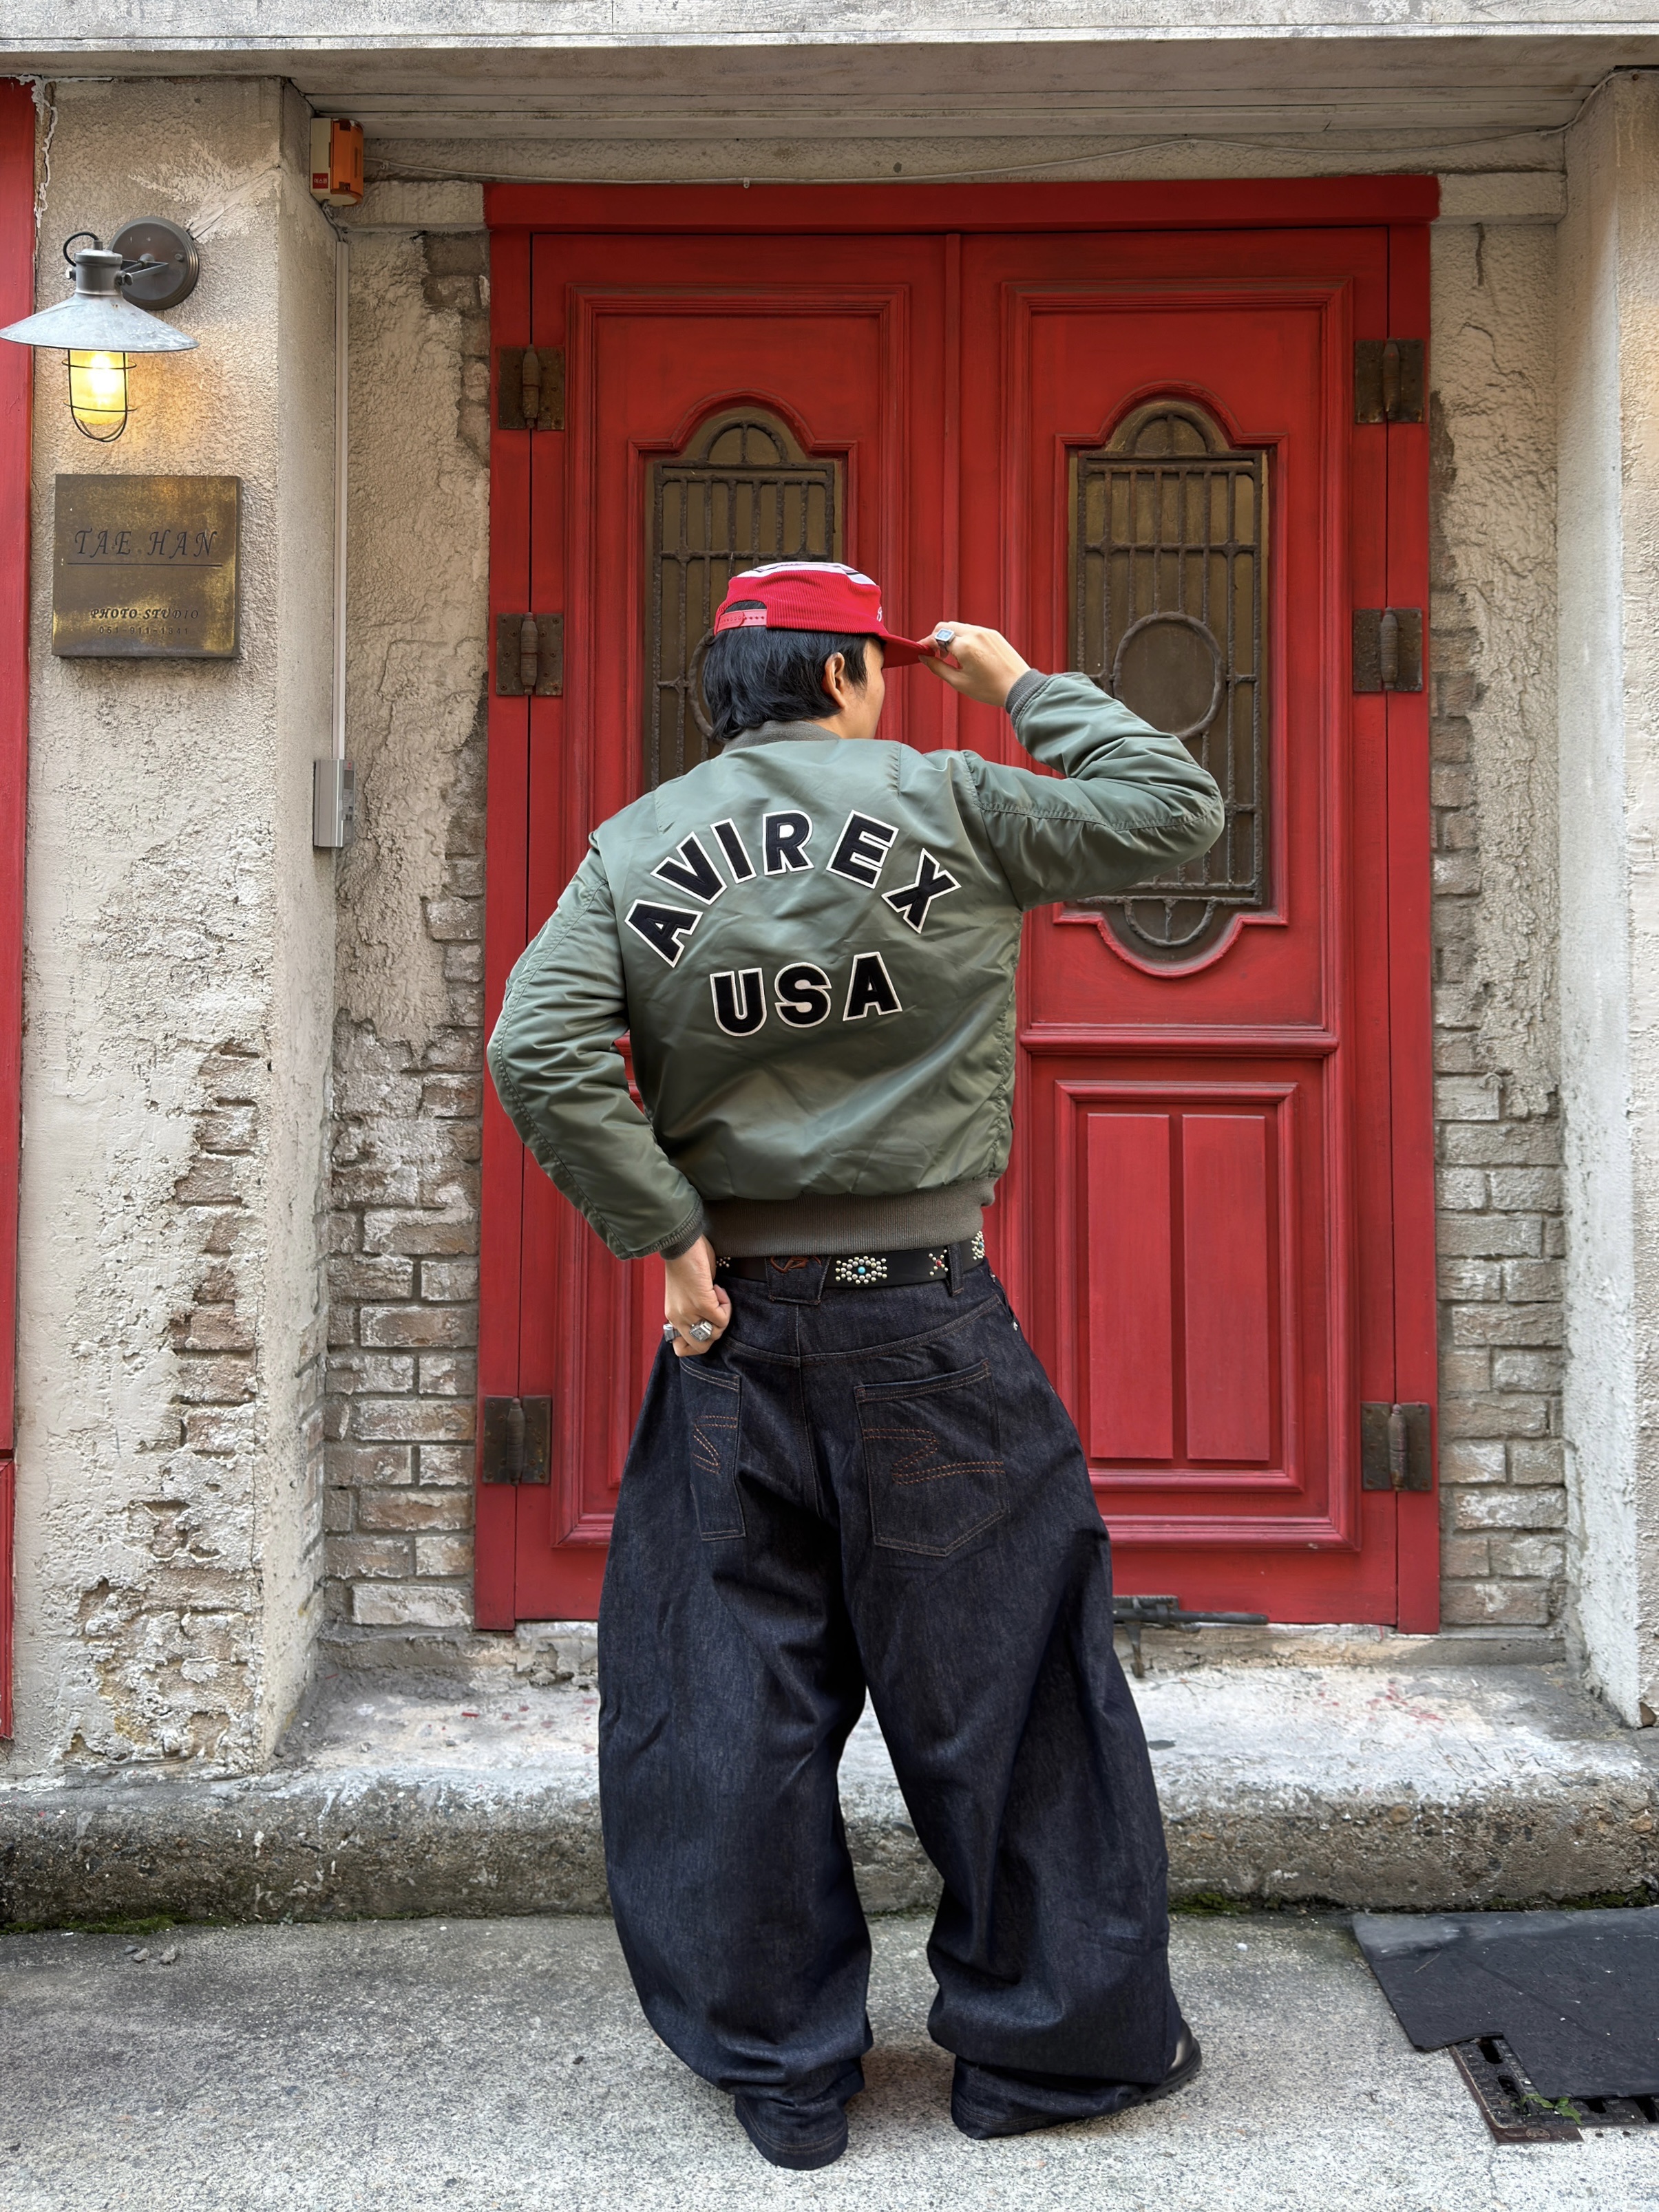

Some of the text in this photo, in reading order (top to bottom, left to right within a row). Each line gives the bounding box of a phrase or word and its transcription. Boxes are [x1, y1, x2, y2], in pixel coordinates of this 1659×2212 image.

[74, 528, 218, 559] TAE HAN
[90, 608, 199, 619] PHOTO STUDIO
[624, 809, 962, 968] AVIREX
[710, 951, 902, 1036] USA
